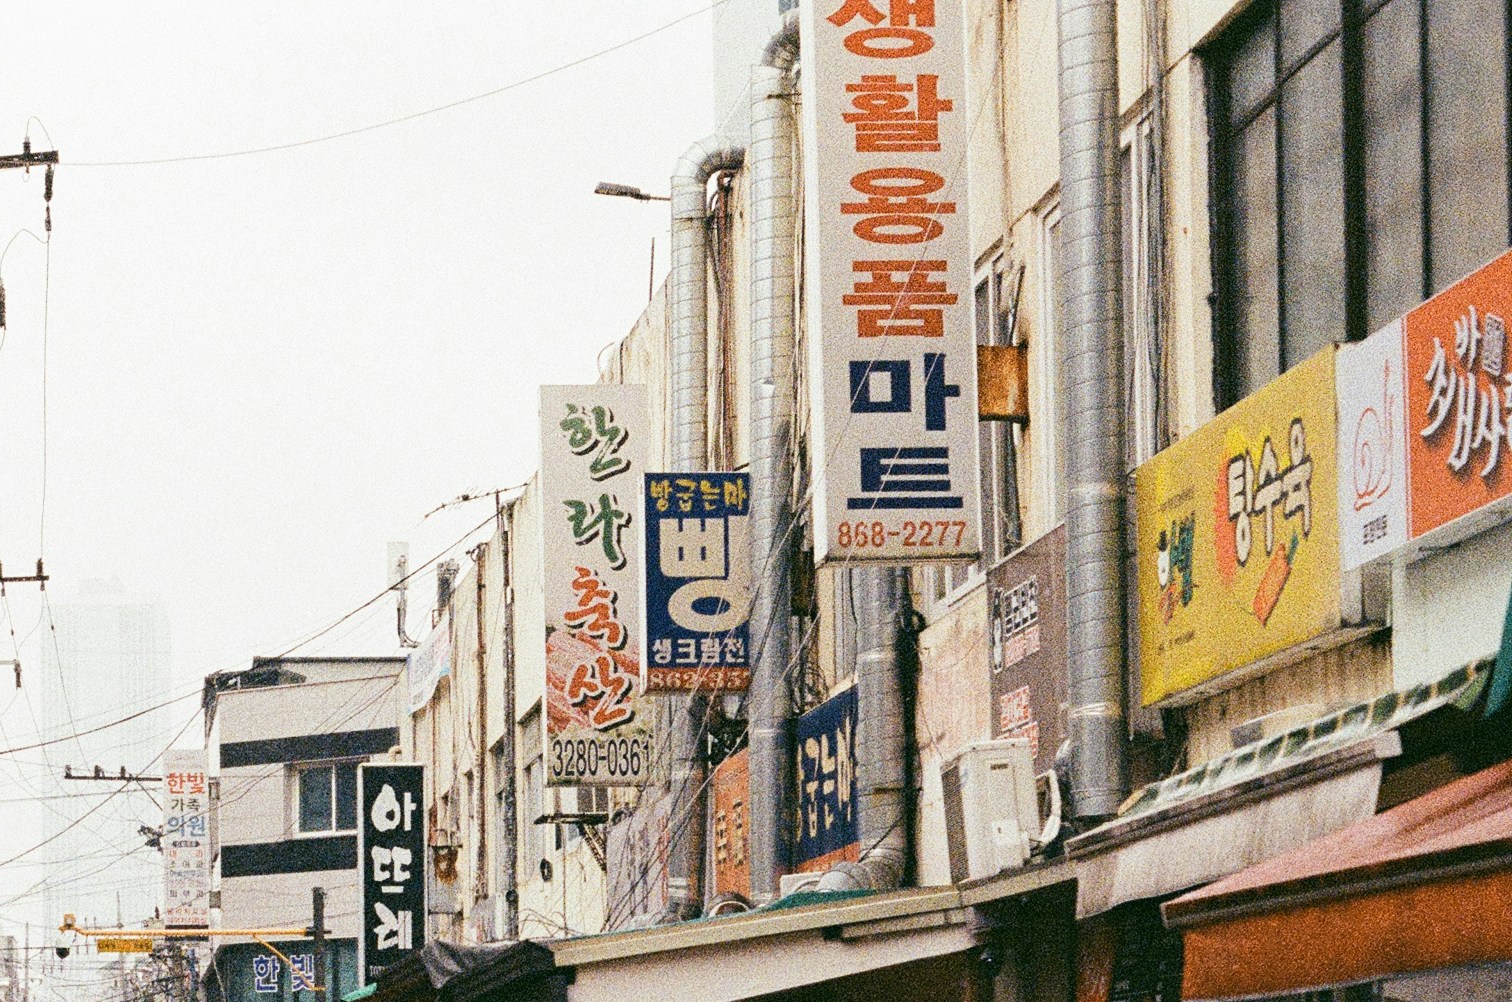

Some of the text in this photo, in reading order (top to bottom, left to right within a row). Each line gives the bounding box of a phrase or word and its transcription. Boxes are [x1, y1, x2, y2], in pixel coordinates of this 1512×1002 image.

[847, 352, 964, 510] 마트
[1226, 418, 1314, 567] 탕수육
[838, 521, 967, 549] 868-2277
[552, 738, 650, 777] 3280-0361
[166, 771, 206, 795] 한빛
[171, 798, 201, 812] 가족
[167, 815, 206, 838] 의원
[371, 783, 417, 952] 아뜨제
[253, 954, 316, 993] 한빛
